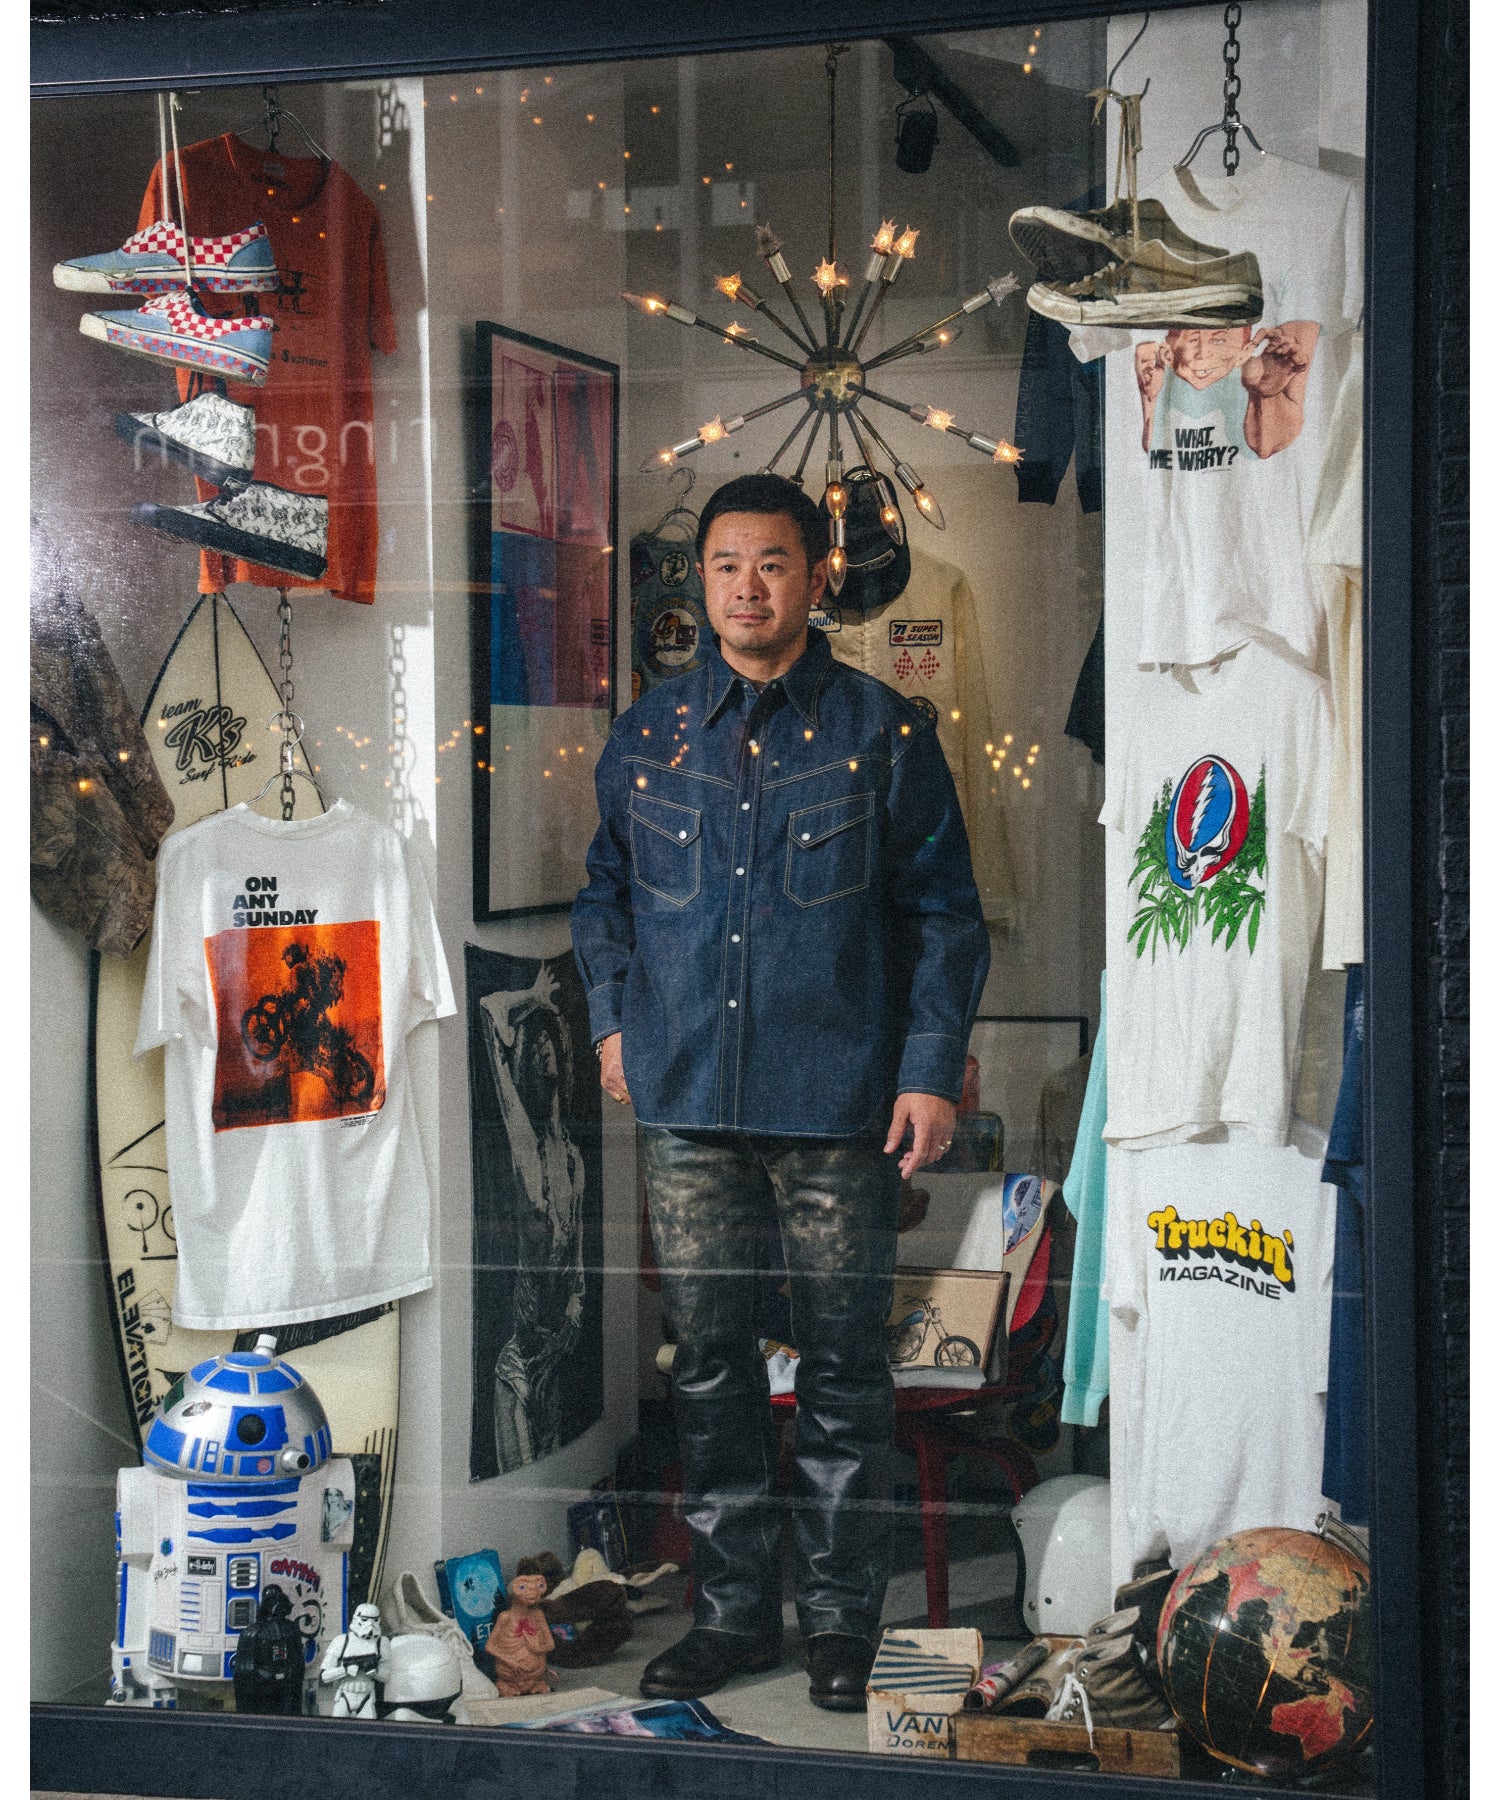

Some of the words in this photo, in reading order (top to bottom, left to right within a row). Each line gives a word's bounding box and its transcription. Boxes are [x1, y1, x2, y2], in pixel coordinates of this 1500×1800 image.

[1175, 426, 1215, 449] WHAT,
[1150, 449, 1173, 470] ME
[1178, 446, 1239, 472] WRRY?
[905, 634, 941, 642] SEASON
[910, 625, 939, 633] SUPER
[162, 699, 202, 720] team
[245, 876, 277, 892] ON
[232, 894, 279, 910] ANY
[233, 909, 319, 928] SUNDAY
[1147, 1205, 1295, 1293] Truckin'
[1160, 1266, 1281, 1300] MAGAZINE
[117, 1268, 155, 1426] ELEVATION
[886, 1711, 949, 1734] VAN
